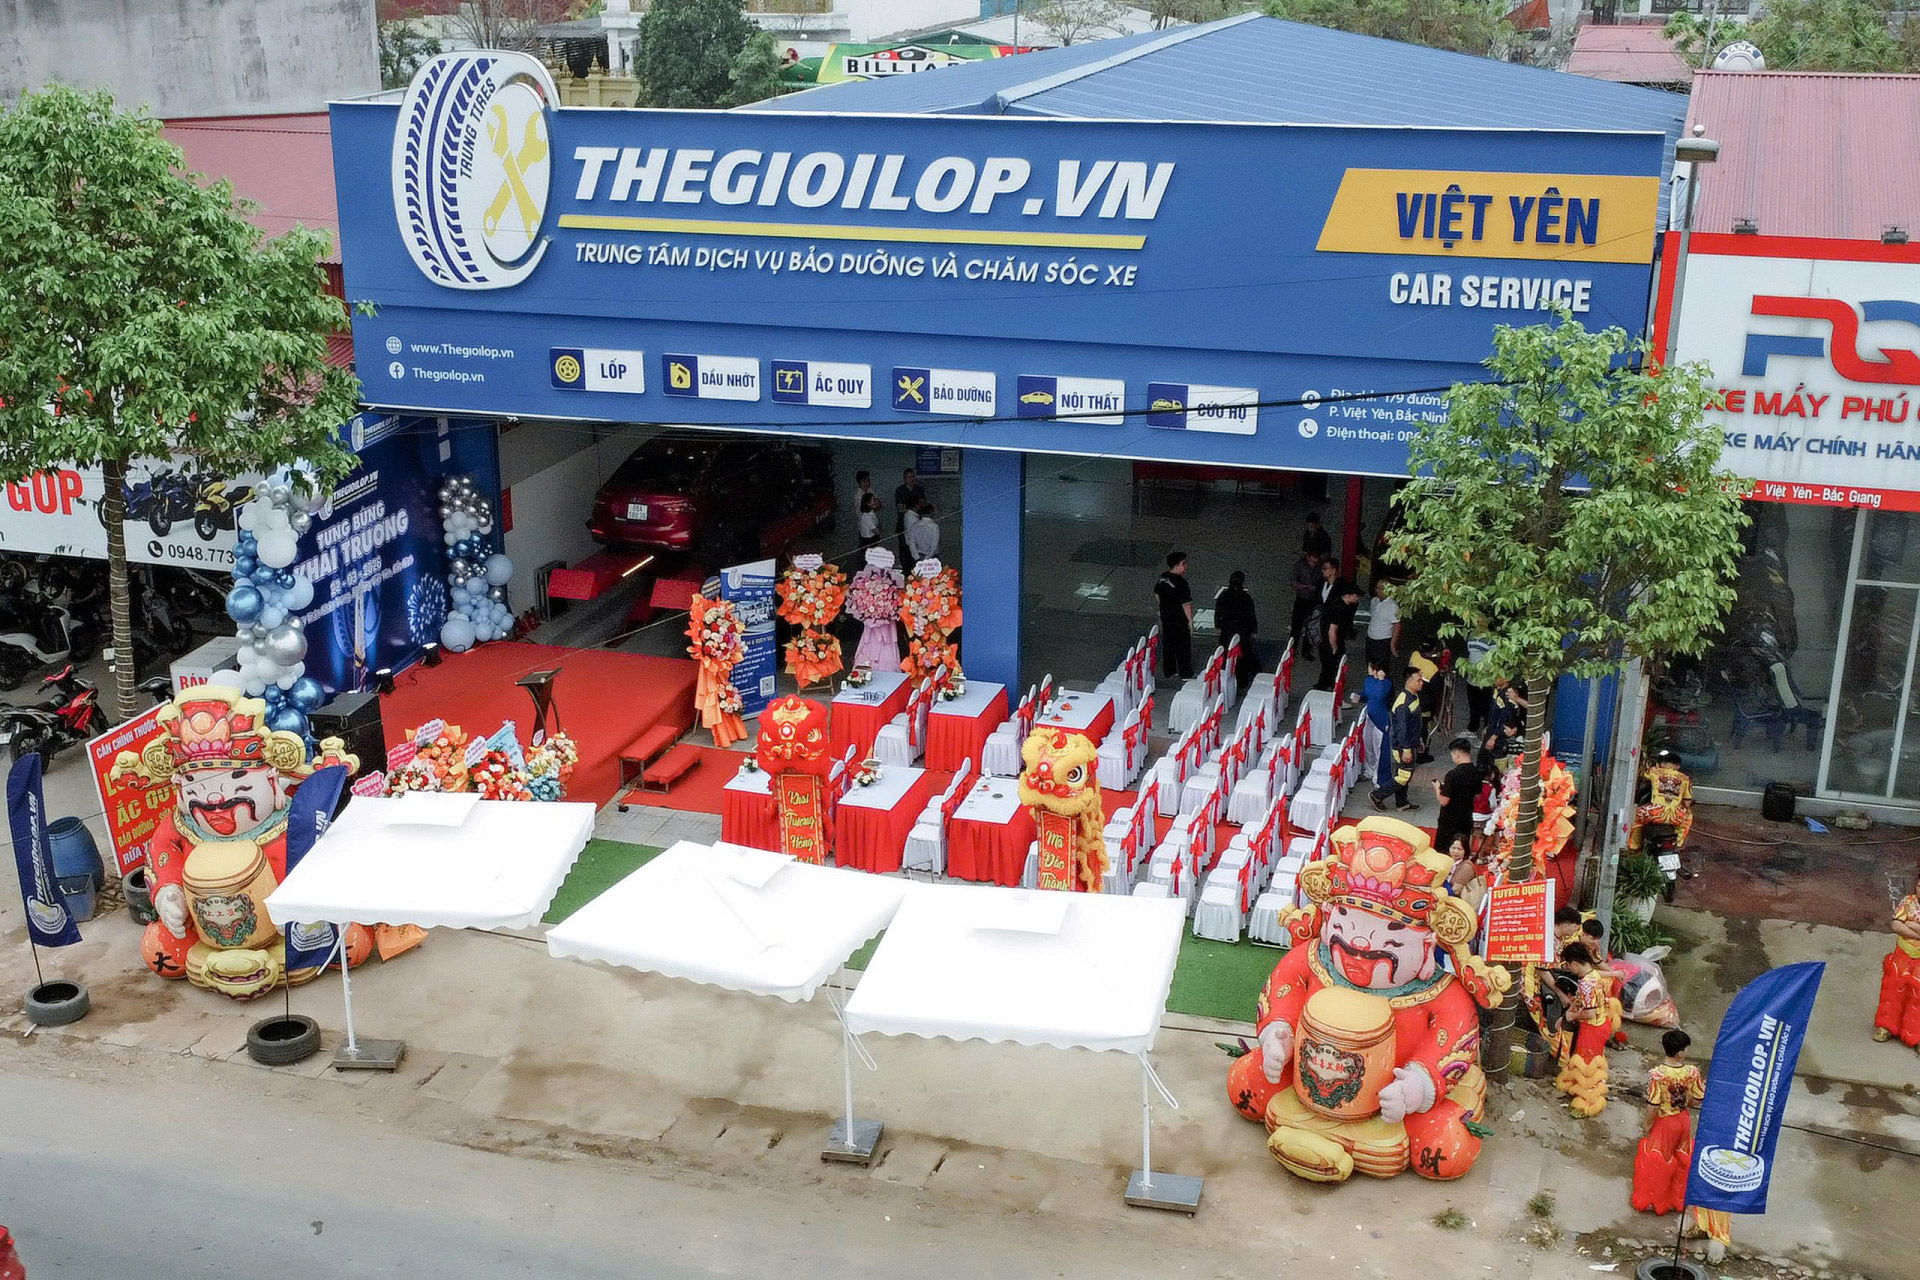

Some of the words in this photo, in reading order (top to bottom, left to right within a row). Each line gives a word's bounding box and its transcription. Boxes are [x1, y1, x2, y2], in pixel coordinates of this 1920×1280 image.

[847, 59, 959, 74] BILLIA
[460, 124, 478, 180] TRUNG
[469, 76, 496, 123] TIRES
[573, 146, 1176, 220] THEGIOILOP.VN
[1396, 183, 1494, 249] VIỆT
[1508, 186, 1601, 246] YÊN
[575, 243, 643, 266] TRUNG
[647, 243, 691, 268] TÂM
[694, 247, 749, 272] DỊCH
[754, 250, 784, 275] VỤ
[788, 245, 834, 274] BẢO
[839, 249, 925, 277] DƯỠNG
[931, 252, 960, 279] VÀ
[963, 255, 1041, 283] CHĂM
[1044, 257, 1100, 285] SÓC
[1103, 264, 1139, 287] XE
[1389, 273, 1453, 306] CAR
[1459, 275, 1592, 313] SERVICE
[600, 358, 628, 380] LỐP
[814, 371, 835, 393] ẮC
[837, 379, 865, 397] QUY
[933, 383, 955, 401] BẢO
[1061, 391, 1084, 412] NỘI
[1088, 391, 1120, 411] THẤT
[1753, 385, 1831, 419] MÁY
[1841, 392, 1910, 425] PHÚ
[1329, 406, 1340, 418] P.
[1342, 406, 1368, 421] Việt
[1421, 411, 1450, 424] Ninh
[1326, 426, 1357, 442] Điện
[1358, 428, 1395, 443] thoại:
[1753, 432, 1801, 451] MÁY
[1805, 435, 1867, 458] CHÍNH
[1764, 484, 1788, 500] Việt
[1792, 486, 1813, 500] Yên
[1822, 487, 1845, 502] Bắc
[1849, 489, 1882, 508] Giang
[1733, 1013, 1778, 1152] THEGIOILOP.VN
